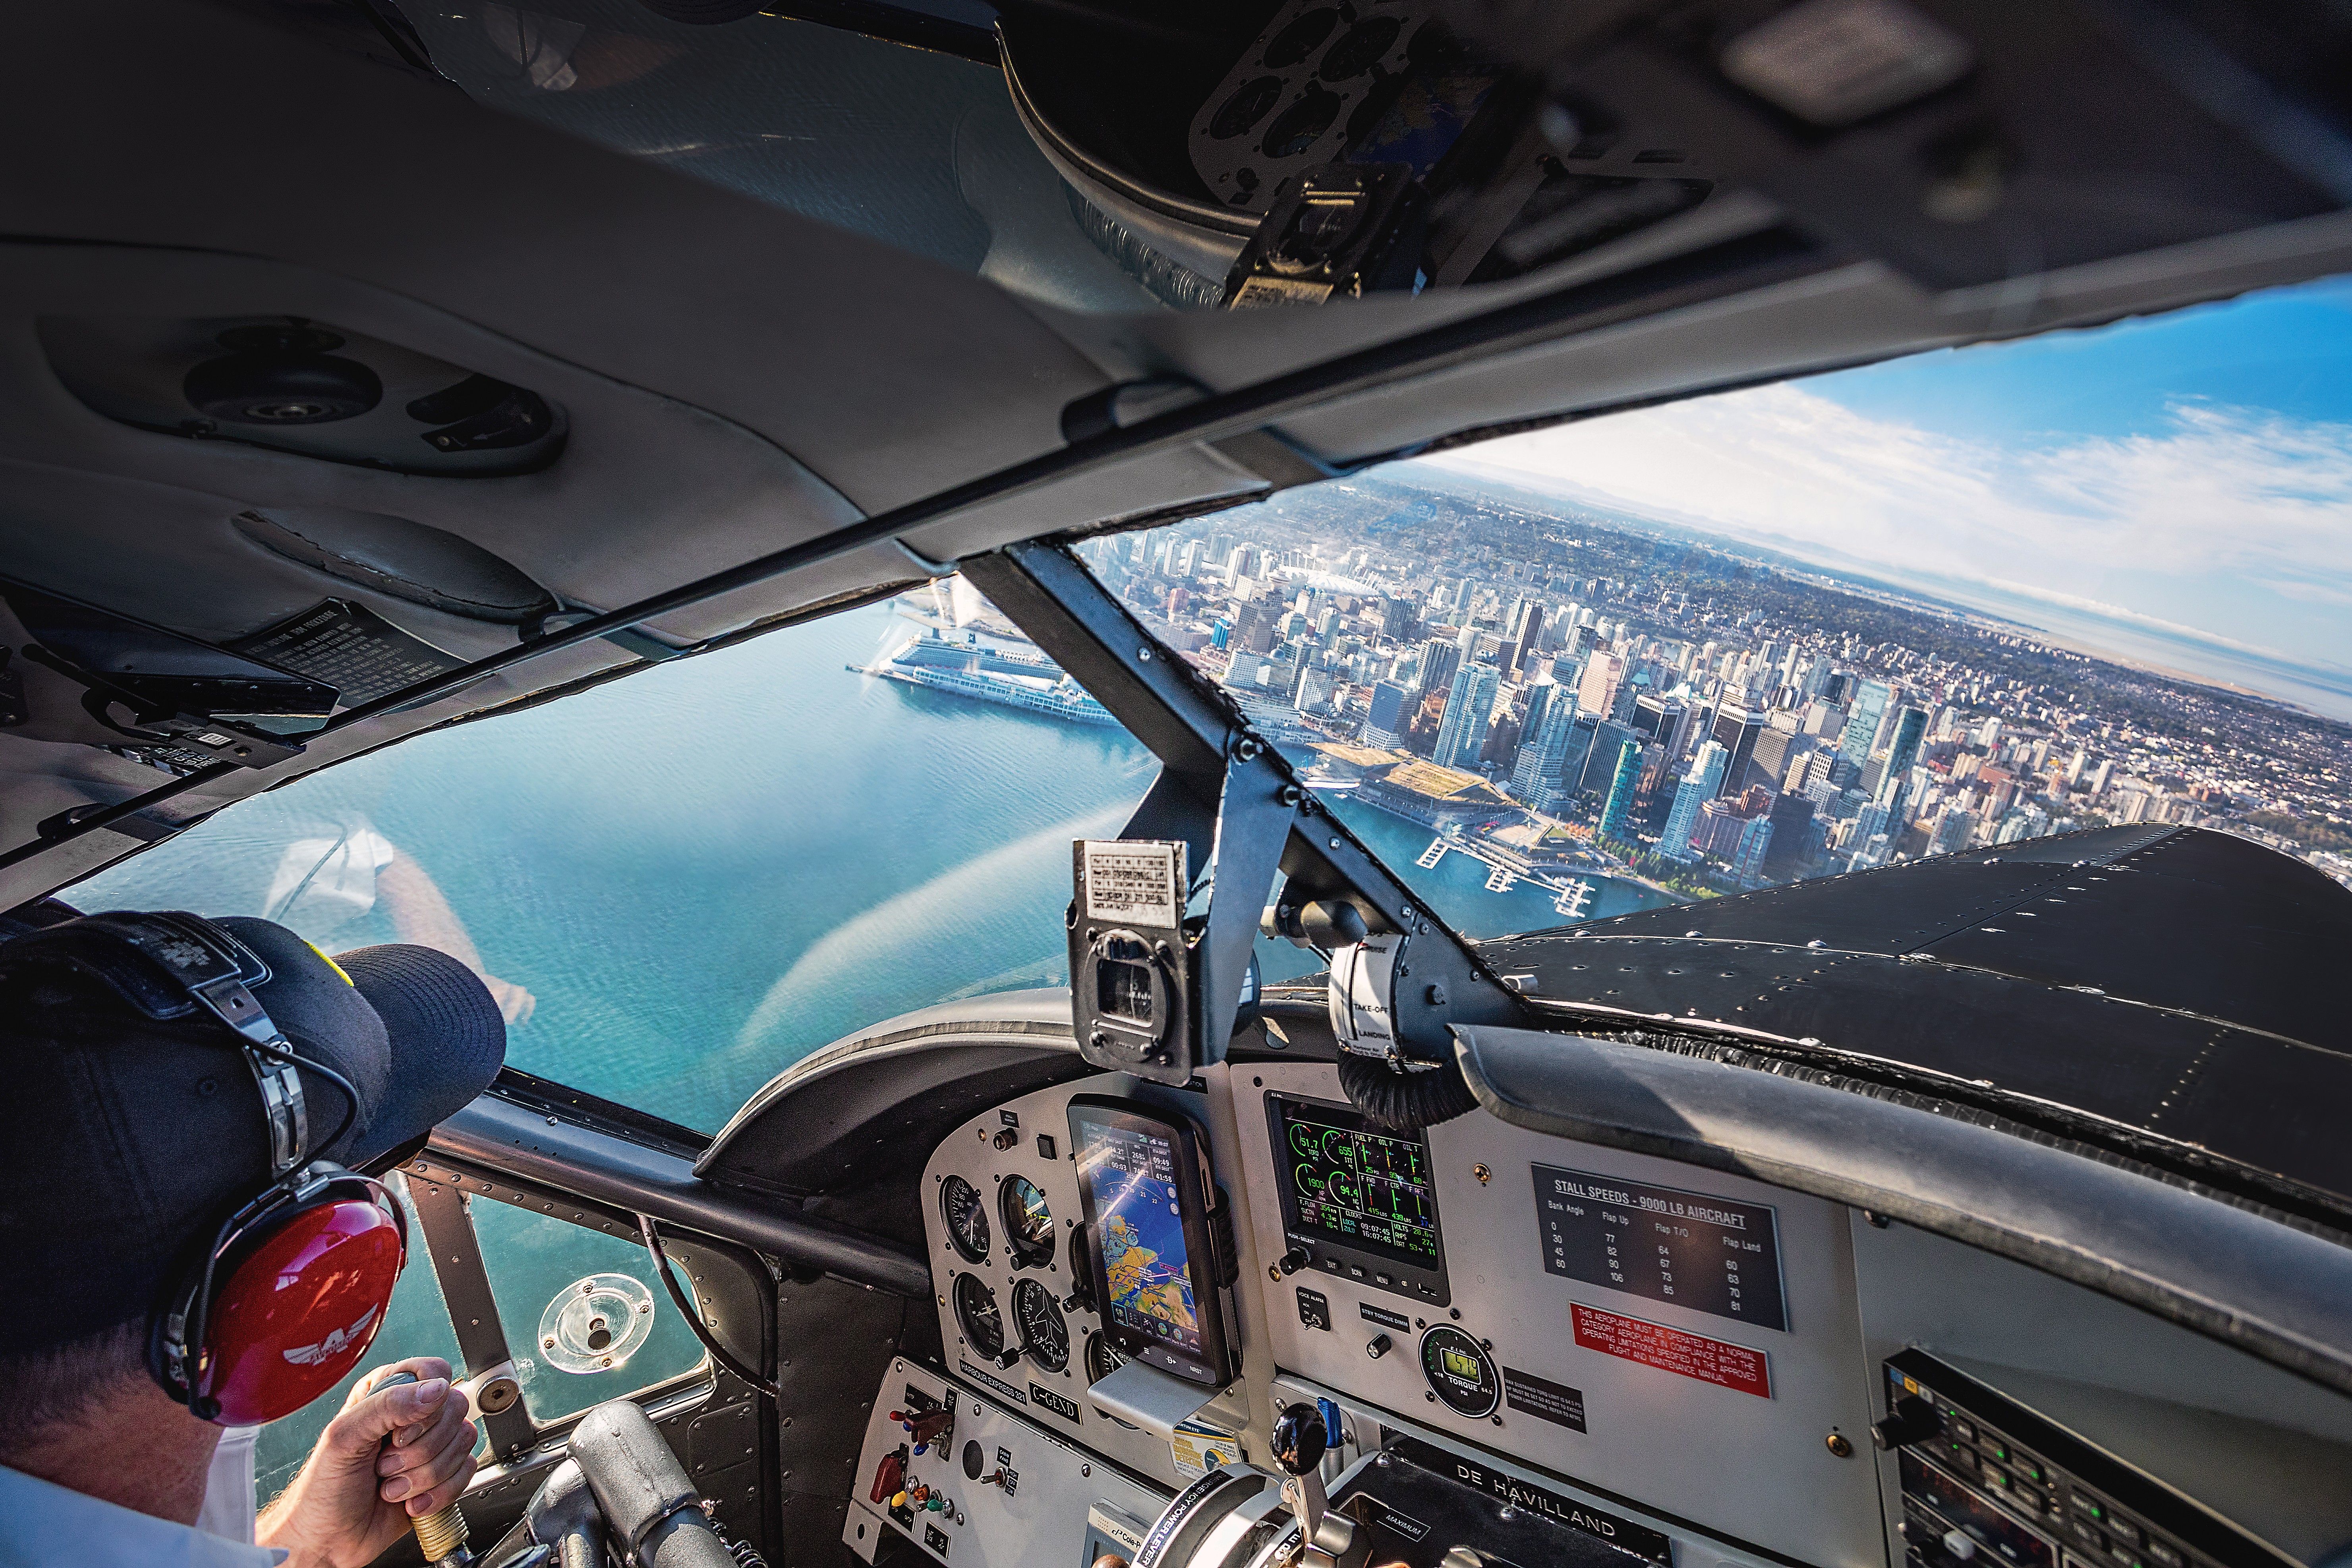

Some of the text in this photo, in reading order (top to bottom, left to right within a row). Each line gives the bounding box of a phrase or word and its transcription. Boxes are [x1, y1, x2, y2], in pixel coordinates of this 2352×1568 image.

[1353, 1003, 1389, 1013] TAKE-OFF
[1301, 1137, 1353, 1156] 51.7 655
[1355, 1133, 1367, 1142] FUEL
[1156, 1173, 1173, 1183] 41:58
[1365, 1166, 1373, 1174] 25
[1308, 1177, 1359, 1198] 1900 94.4
[1555, 1179, 1586, 1196] STALL
[1588, 1186, 1629, 1205] SPEEDS
[1639, 1196, 1667, 1212] 9000
[1670, 1202, 1684, 1215] LB
[1688, 1205, 1745, 1227] AIRCRAFT
[1321, 1212, 1332, 1220] 4.3
[1345, 1210, 1362, 1219] CLOCKS
[1368, 1206, 1404, 1221] 415 439
[1343, 1218, 1390, 1236] LOCAL 09:07:45
[1393, 1224, 1409, 1233] VOLTS
[1548, 1200, 1762, 1253] Bank Angle Flap Up Flap T/O Flap Land
[1362, 1230, 1391, 1243] 16:07:45
[1395, 1232, 1407, 1240] AMPS
[1409, 1243, 1418, 1251] 53
[1551, 1222, 1738, 1271] 0 77 64 60
[1553, 1234, 1563, 1243] 30
[1607, 1246, 1618, 1257] 82
[1351, 1268, 1362, 1277] SCRN
[1555, 1247, 1564, 1256] 45
[1608, 1259, 1620, 1269] 90
[1729, 1286, 1740, 1298] 70
[1556, 1259, 1566, 1268] 60
[1610, 1272, 1624, 1282] 106
[1377, 1276, 1388, 1285] MENU
[1311, 1295, 1324, 1303] ALARM
[1362, 1308, 1409, 1328] STBY TORQUE DIMM
[1578, 1309, 1592, 1319] THIS
[1595, 1313, 1632, 1329] AEROPLANE
[1634, 1323, 1652, 1334] MUST
[1655, 1329, 1665, 1338] BE
[1668, 1332, 1703, 1348] OPERATED
[1707, 1342, 1716, 1351] AS
[1727, 1347, 1757, 1362] NORMAL
[1581, 1319, 1615, 1334] CATEGORY
[1618, 1328, 1658, 1346] AEROPLANE
[1670, 1342, 1716, 1361] COMPLIANCE
[1718, 1355, 1736, 1366] WITH
[1740, 1360, 1755, 1372] THE
[1582, 1328, 1616, 1343] OPERATING
[1618, 1338, 1655, 1354] LIMITATIONS
[1657, 1348, 1691, 1364] SPECIFIED
[1703, 1360, 1717, 1371] THE
[1720, 1365, 1757, 1382] APPROVED
[1609, 1344, 1728, 1384] FLIGHT AND MAINTENANCE MANUAL
[1190, 1365, 1202, 1375] NRST
[961, 1362, 1026, 1402] HARBOUR EXPRESS 321
[1448, 1377, 1478, 1392] TORQUE
[1514, 1381, 1536, 1393] SUSTAINED
[1033, 1387, 1074, 1417] C-GEND
[1508, 1392, 1523, 1401] POWER
[1549, 1407, 1563, 1415] REFER
[1567, 1406, 1583, 1415] EXCEED
[999, 1450, 1010, 1458] CABIN
[1185, 1473, 1227, 1506] EMERGENCY
[1457, 1465, 1616, 1537] DE HAVILLAND
[1160, 1504, 1187, 1535] POWER
[1385, 1514, 1422, 1535] MAXIMUM
[1123, 1533, 1141, 1549] Cole-P
[1142, 1533, 1165, 1566] LEVER
